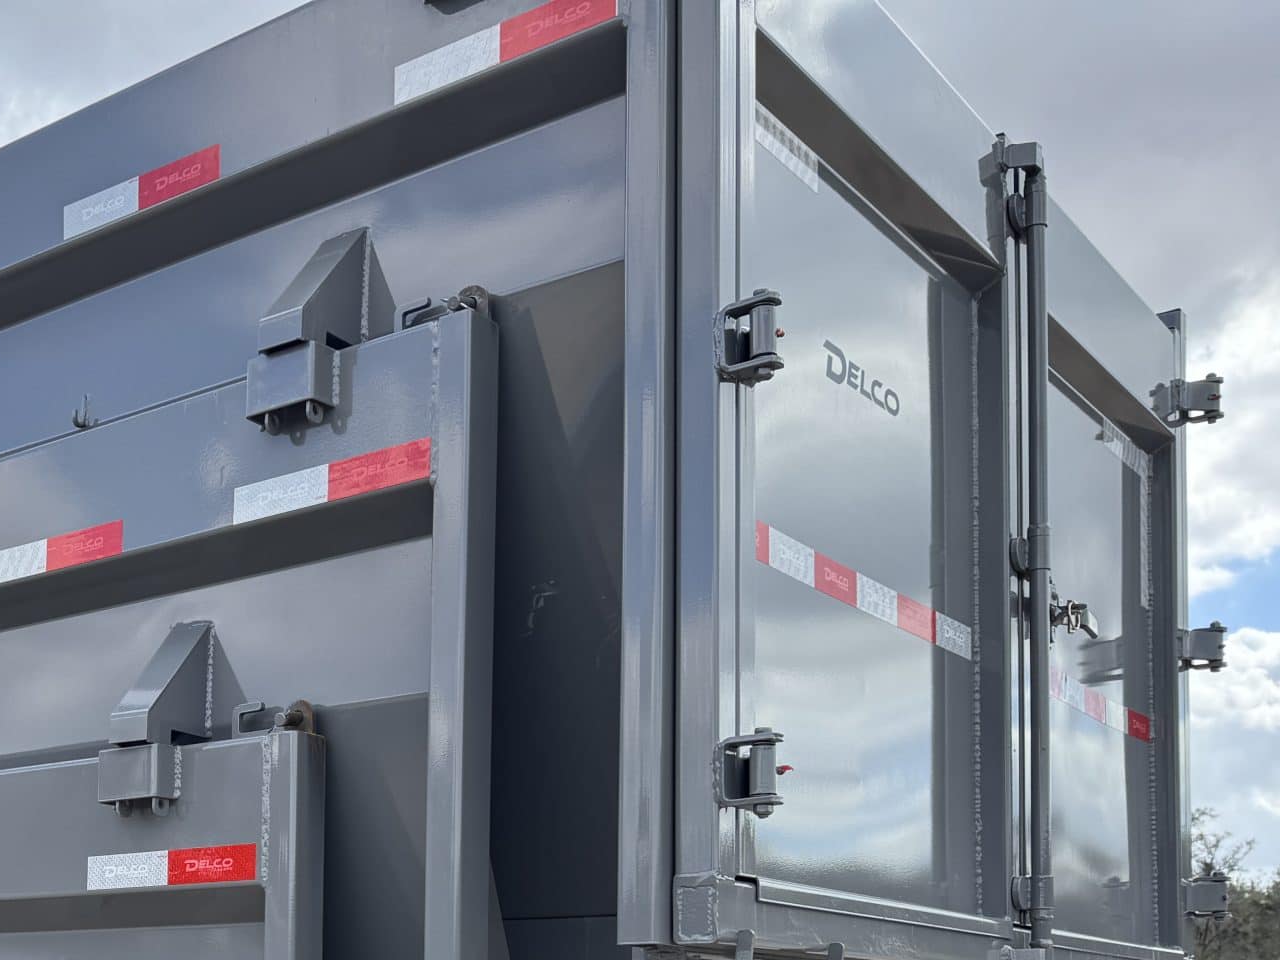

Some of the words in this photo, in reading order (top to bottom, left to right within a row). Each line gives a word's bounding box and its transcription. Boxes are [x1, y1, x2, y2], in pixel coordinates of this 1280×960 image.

[526, 2, 591, 38] DELCO
[154, 163, 202, 191] DELCO
[82, 195, 124, 221] DELCO
[823, 339, 899, 416] DELCO
[351, 457, 408, 481] DELCO
[63, 536, 104, 555] DELCO
[823, 567, 849, 588] DELCO
[104, 864, 148, 878] DELCO
[183, 857, 233, 873] DELCO
